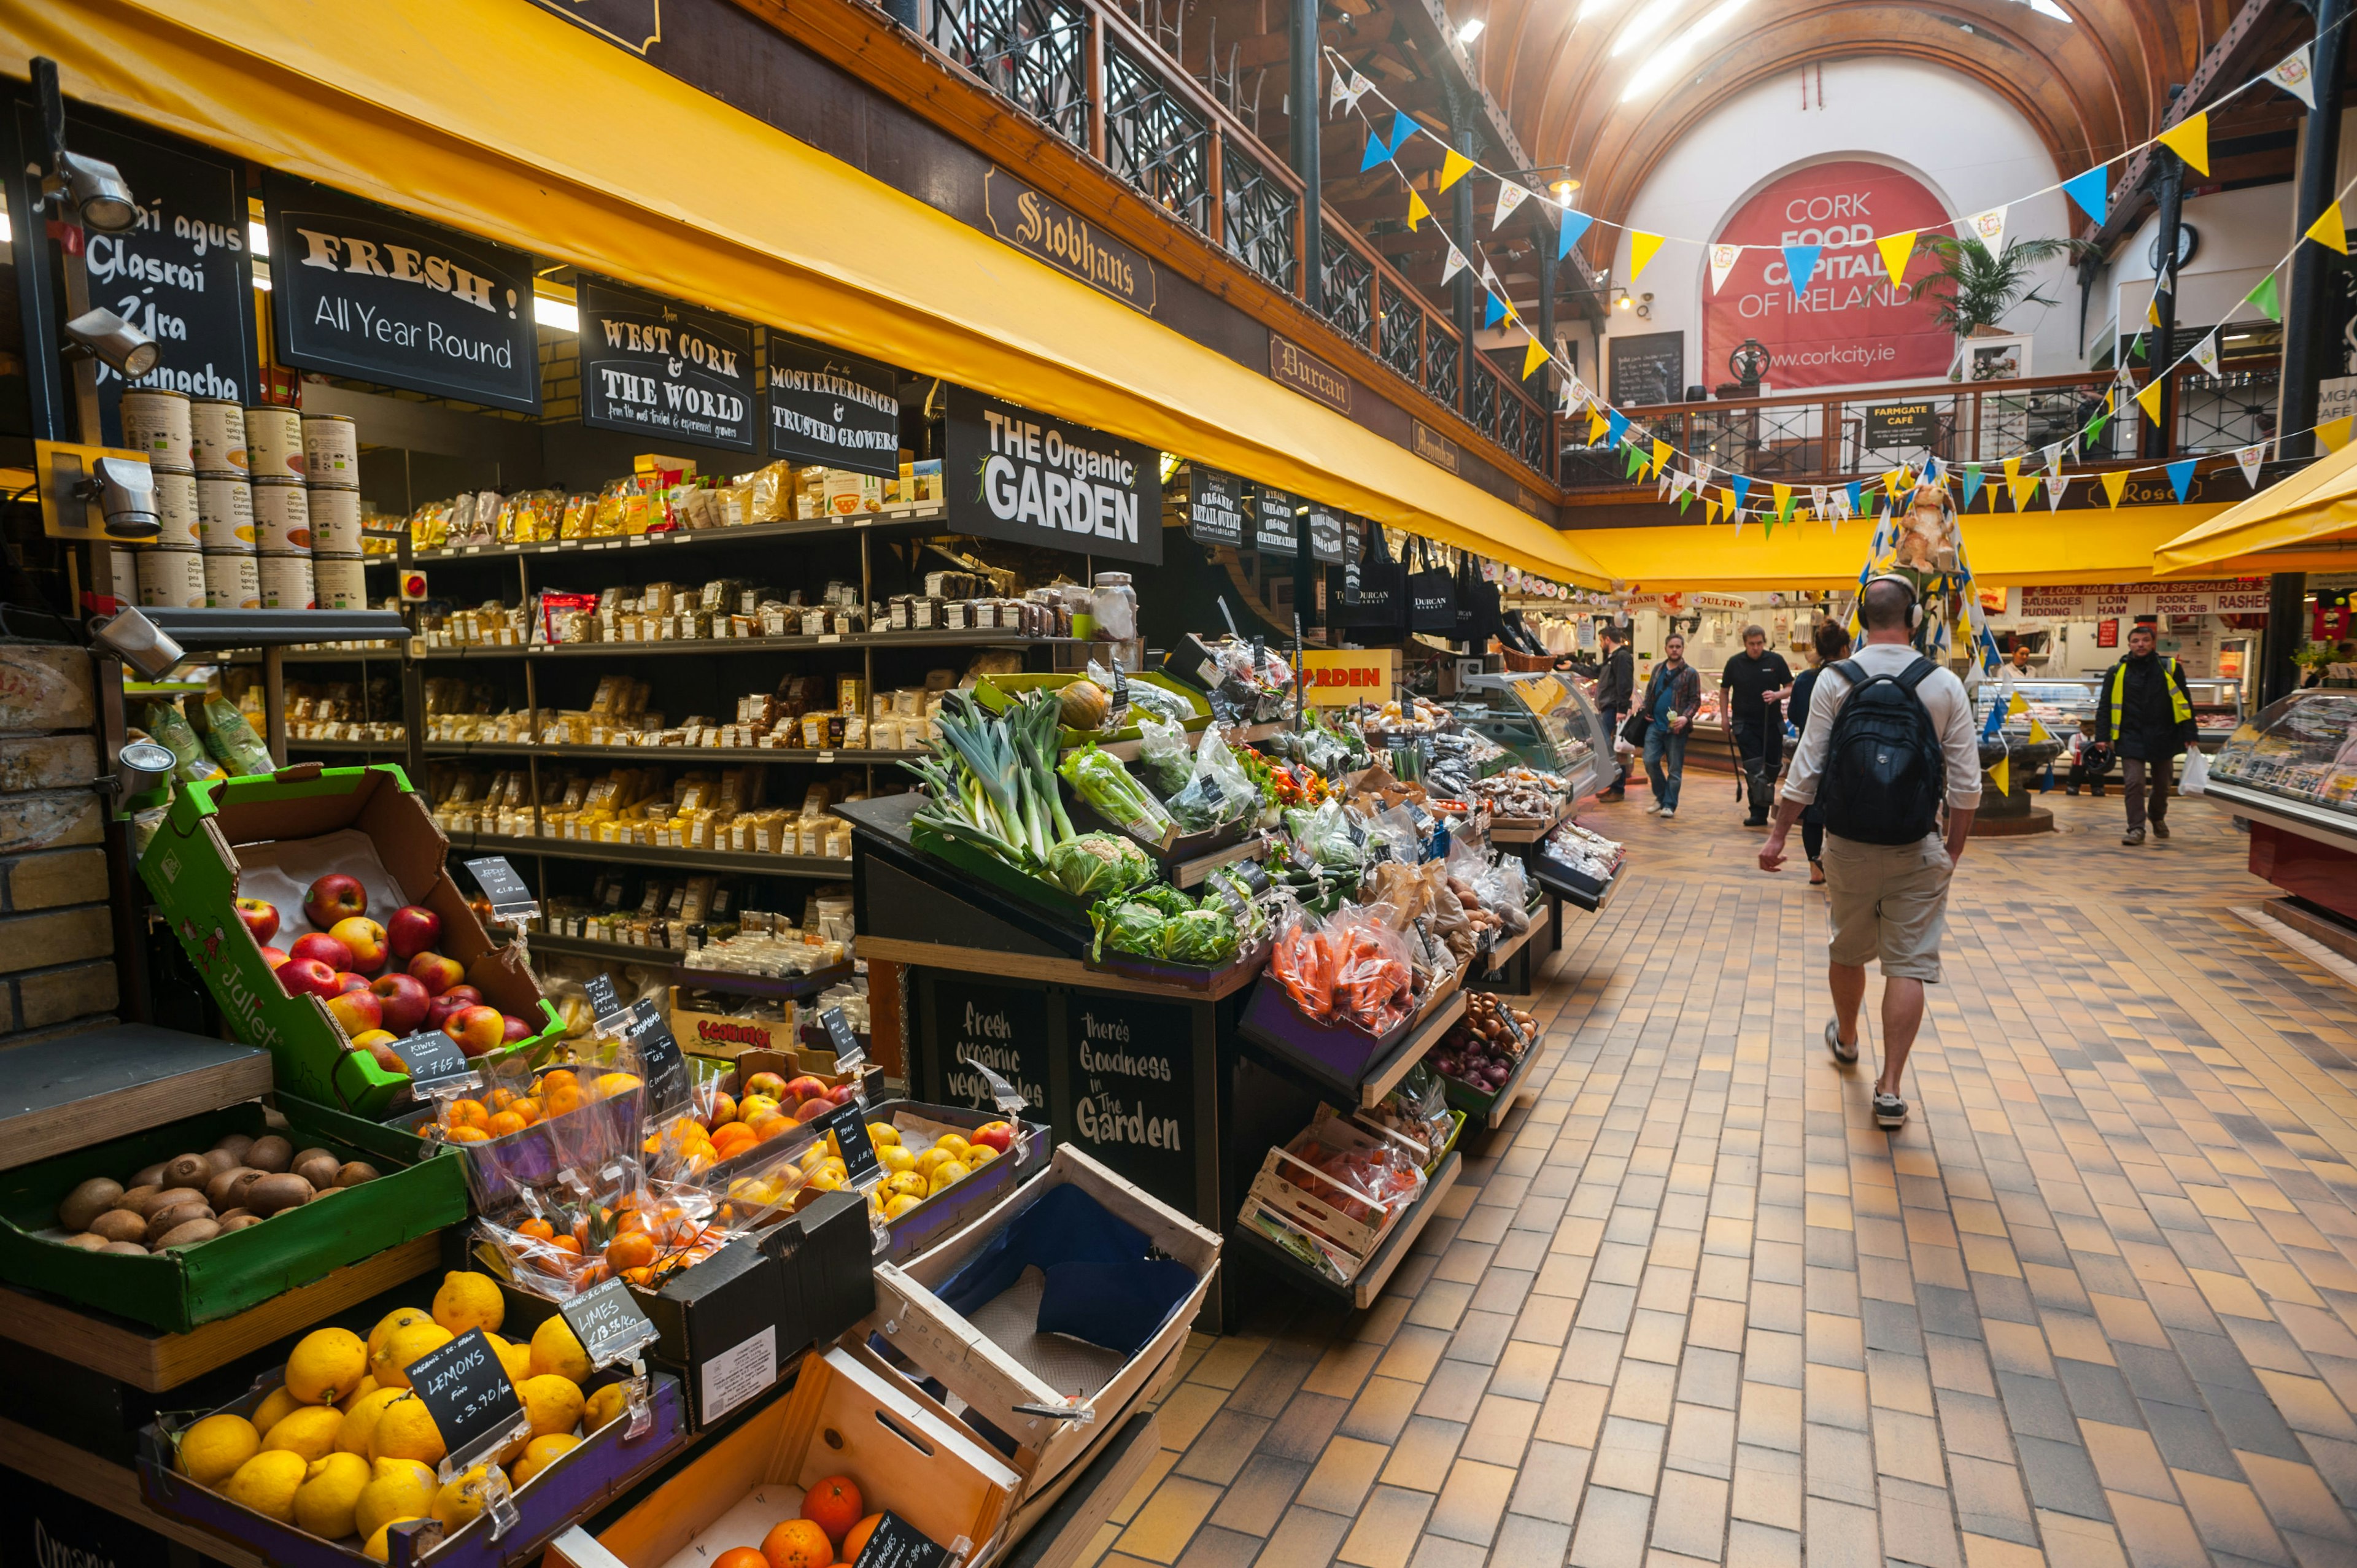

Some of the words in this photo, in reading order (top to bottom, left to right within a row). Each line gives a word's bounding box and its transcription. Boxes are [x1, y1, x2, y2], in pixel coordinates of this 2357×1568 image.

[1786, 191, 1871, 223] CORK
[174, 215, 242, 257] agus
[1016, 191, 1134, 296] Siobhan's
[1781, 223, 1874, 255] FOOD
[296, 228, 497, 313] FRESH
[506, 288, 517, 319] !
[1763, 252, 1889, 286] CPITAL
[662, 304, 678, 323] from
[1738, 292, 1780, 318] OF
[1787, 282, 1914, 314] IRELAND
[315, 295, 350, 332] All
[356, 302, 422, 347] Year
[428, 321, 511, 369] Round
[601, 319, 671, 355] WEST
[679, 333, 740, 379] CORK
[668, 357, 684, 377] &
[1280, 341, 1345, 404] Durcan
[602, 368, 657, 405] THE
[663, 380, 743, 423] WORLD
[770, 365, 811, 391] MOST
[811, 371, 899, 417] EXPERIENCED
[608, 402, 624, 420] from
[625, 403, 635, 419] the
[650, 408, 670, 426] trusted
[681, 418, 711, 435] experienced
[834, 401, 844, 423] &
[1874, 406, 1927, 416] FARMGATE
[1887, 414, 1914, 425] CAFÉ
[2318, 404, 2352, 419] AFÉ
[772, 405, 836, 444] TRUSTED
[837, 427, 899, 452] GROWERS
[983, 409, 1042, 463] THE
[1045, 430, 1134, 487] Organic
[985, 455, 1138, 544] GARDEN
[1201, 492, 1234, 512] ORGANIC
[1193, 503, 1217, 525] RETAIL
[1218, 510, 1241, 531] OUTLET
[1265, 518, 1289, 534] ORGANIC
[1257, 531, 1298, 549] CERTIFICATION
[1415, 597, 1447, 606] DURCAN
[1627, 594, 1656, 606] HANS
[1701, 595, 1746, 609] OULTRY
[2022, 596, 2083, 606] SAUSAGES
[2084, 584, 2110, 594] HAM
[2112, 584, 2121, 593] &
[2124, 582, 2168, 593] BACON
[2172, 581, 2254, 593] SPECIALISTS
[2097, 595, 2129, 604] LOIN
[2156, 594, 2198, 604] BODICE
[2022, 606, 2071, 617] PUDDING
[2097, 605, 2127, 615] HAM
[2156, 604, 2186, 614] PORK
[2189, 604, 2208, 613] RIB
[222, 963, 278, 1048] Juliet
[963, 1001, 1012, 1039] fresh
[411, 1040, 436, 1052] KIWIS
[956, 1041, 1021, 1075] organic
[648, 1061, 681, 1089] Clementines
[1080, 1040, 1172, 1082] Goodness
[948, 1072, 1043, 1110] vegeles
[1089, 1073, 1104, 1094] in
[1094, 1091, 1123, 1116] The
[840, 1123, 854, 1137] PEAR
[1076, 1097, 1181, 1151] Garden
[1292, 1242, 1316, 1261] CAROTA
[578, 1299, 619, 1332] LIMES
[427, 1349, 485, 1396] LEMONS
[880, 1515, 892, 1534] ITALY
